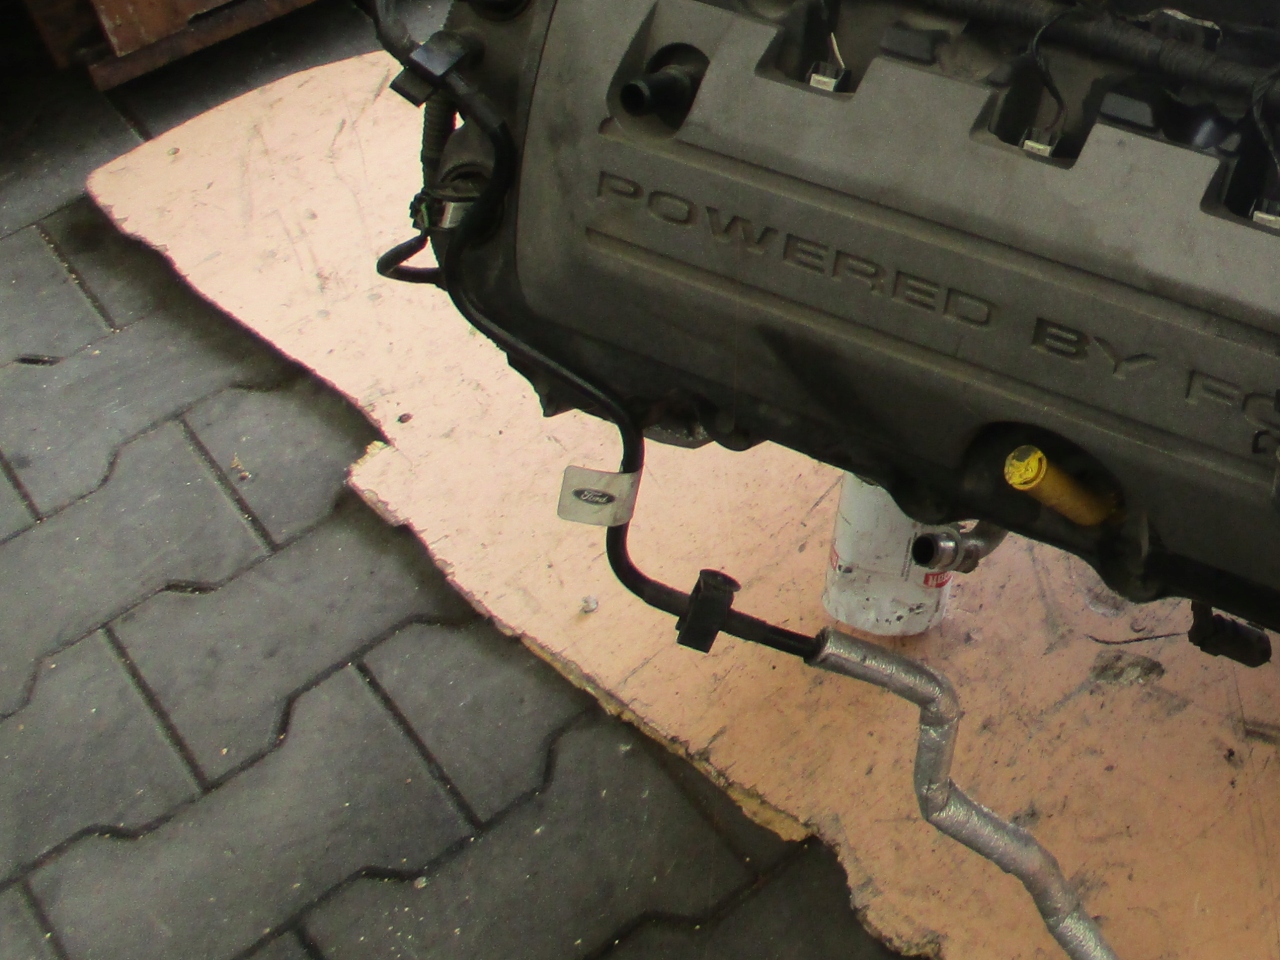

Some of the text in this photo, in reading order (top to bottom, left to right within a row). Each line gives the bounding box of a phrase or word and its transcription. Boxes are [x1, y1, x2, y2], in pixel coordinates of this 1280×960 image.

[596, 170, 1001, 329] POWERED
[1030, 316, 1158, 381] BY
[579, 489, 610, 504] Ford
